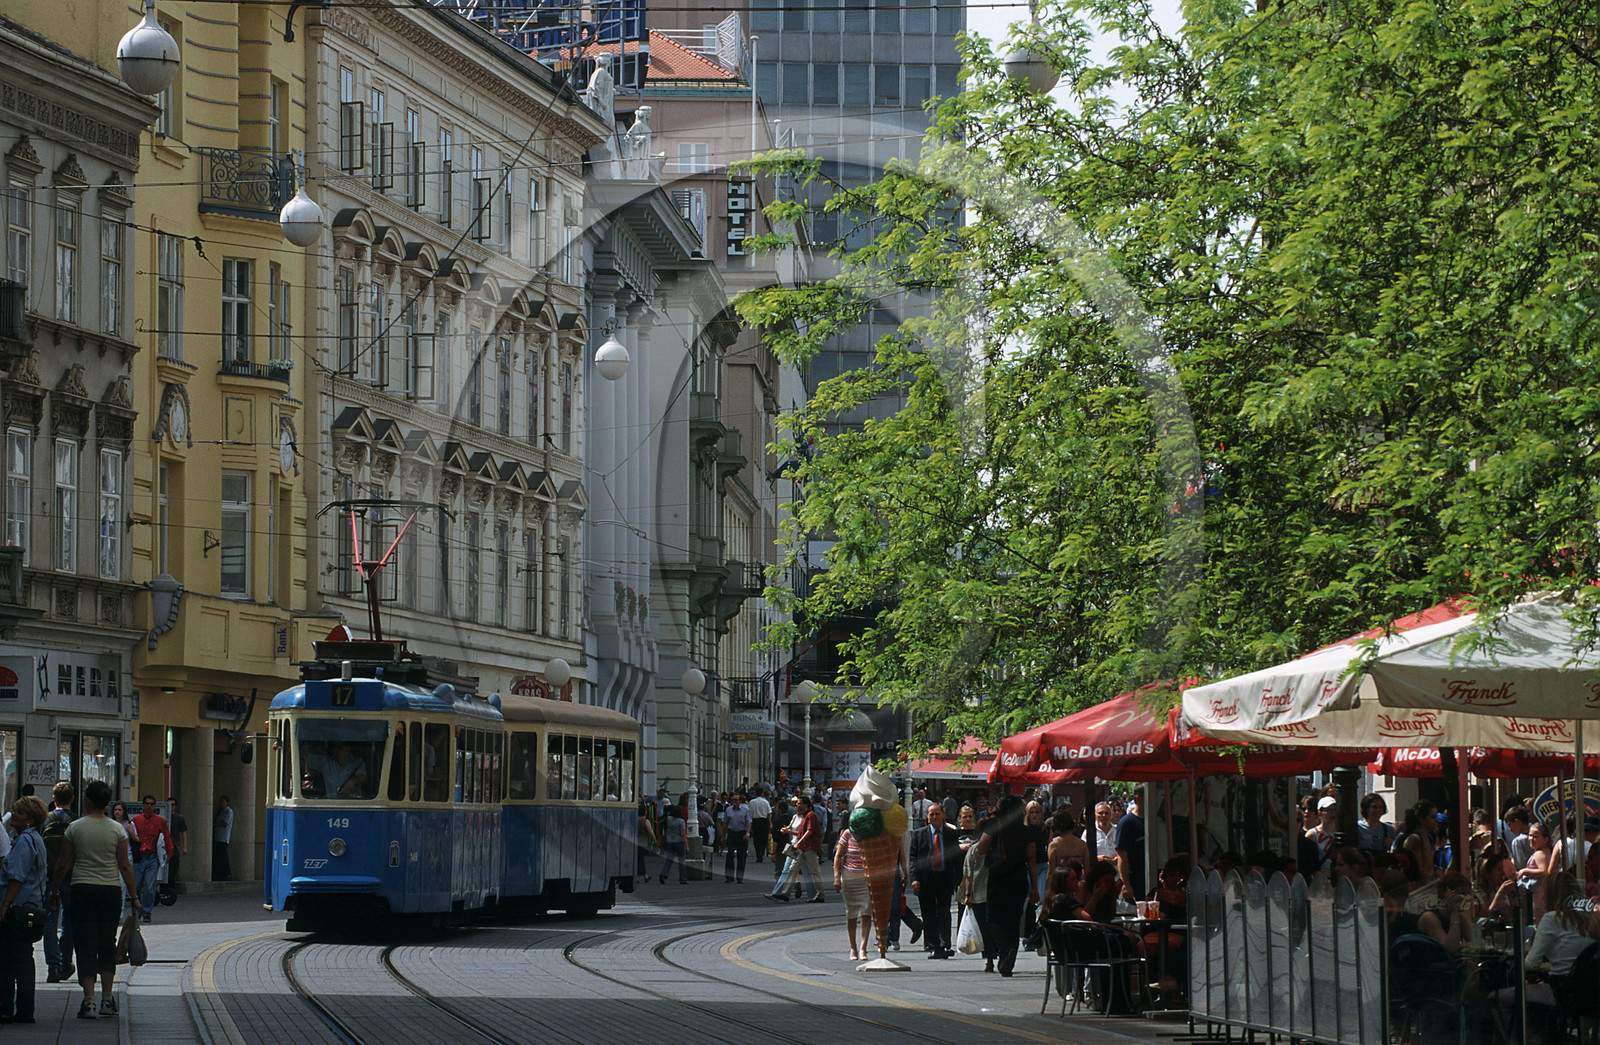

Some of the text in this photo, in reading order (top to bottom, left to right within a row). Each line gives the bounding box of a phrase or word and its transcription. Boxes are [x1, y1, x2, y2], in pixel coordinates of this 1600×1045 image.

[728, 183, 745, 255] HOTEL
[277, 628, 287, 653] Bank
[58, 664, 118, 699] NERA
[1442, 680, 1517, 701] Franck
[335, 686, 353, 706] 17
[1260, 688, 1295, 710] Franck
[1207, 699, 1240, 720] Franck
[1053, 740, 1155, 761] McDonald's
[327, 818, 350, 828] 149
[303, 859, 328, 869] ZET
